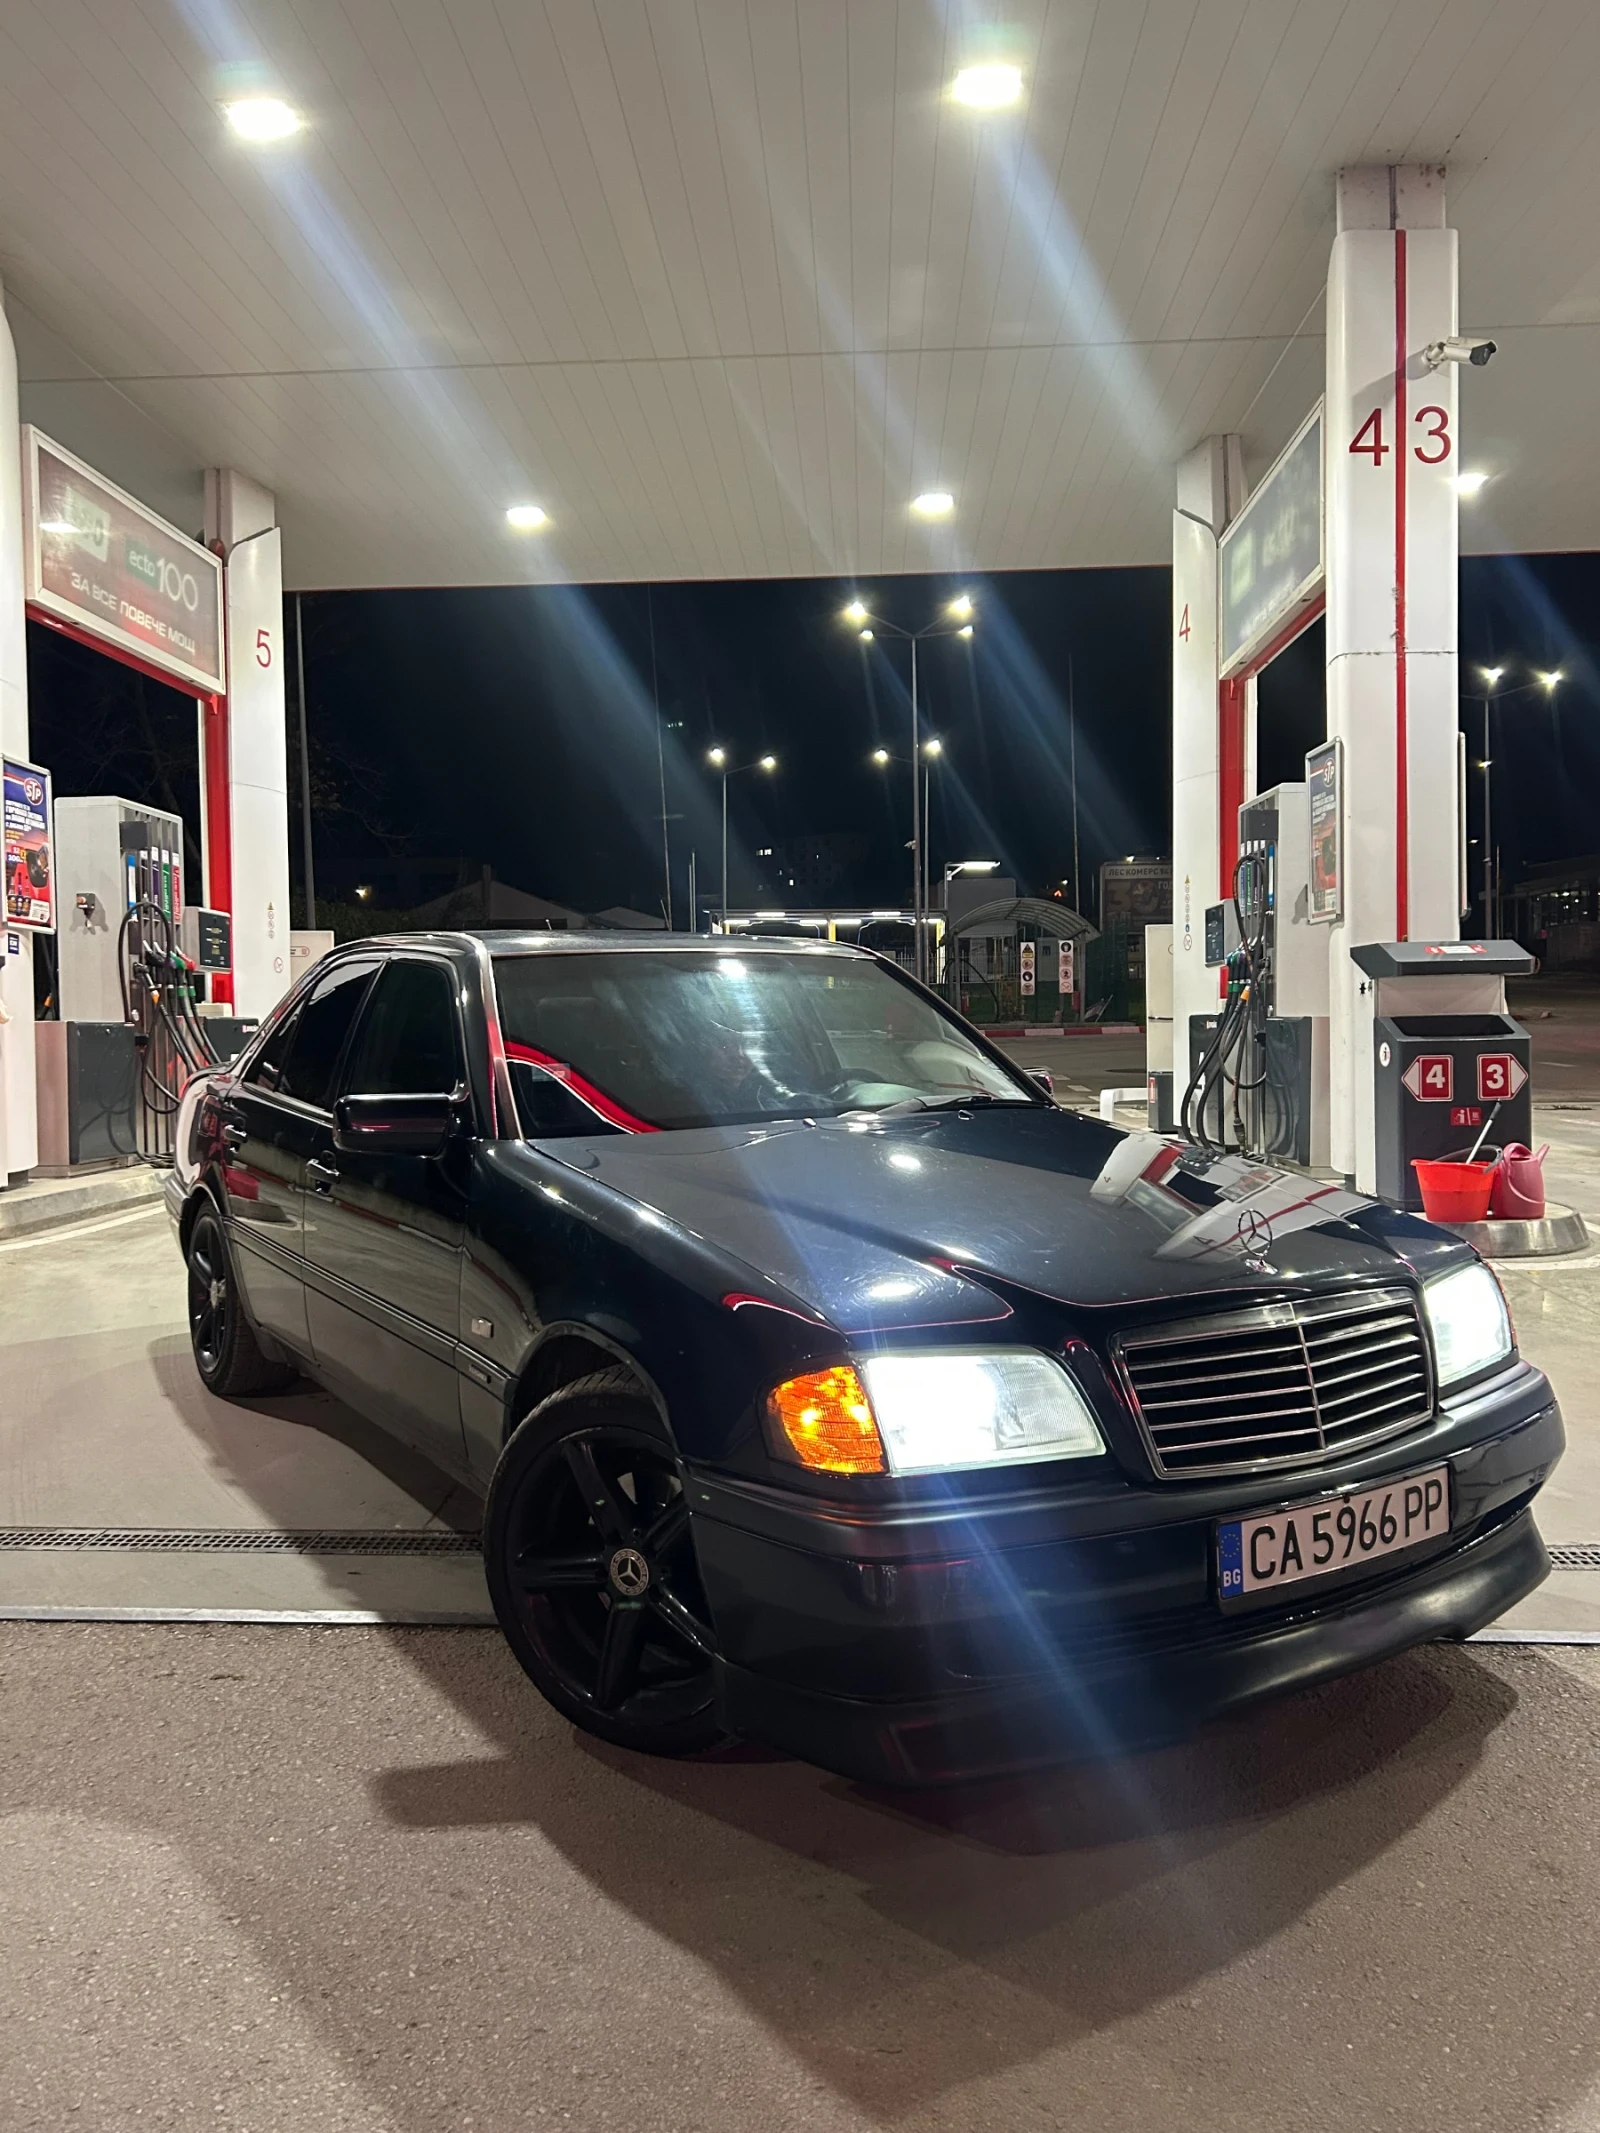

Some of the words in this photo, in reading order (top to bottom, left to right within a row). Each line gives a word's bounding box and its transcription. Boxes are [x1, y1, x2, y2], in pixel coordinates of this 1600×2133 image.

[1349, 408, 1389, 466] 4
[1414, 405, 1452, 464] 3
[128, 550, 155, 577] ecto
[156, 557, 199, 612] 100
[71, 571, 90, 596] ЗА
[92, 584, 118, 611] ВСЕ
[119, 600, 167, 638] ПОВЕЧЕ
[167, 627, 196, 656] МОЩ
[1178, 603, 1191, 643] 4
[255, 628, 272, 668] 5
[26, 780, 42, 801] STP
[1425, 1064, 1446, 1089] 4
[1486, 1064, 1505, 1090] 3
[1250, 1518, 1303, 1580] CA
[1312, 1493, 1398, 1565] 5966
[1404, 1478, 1443, 1538] PP
[1223, 1568, 1242, 1588] BG
